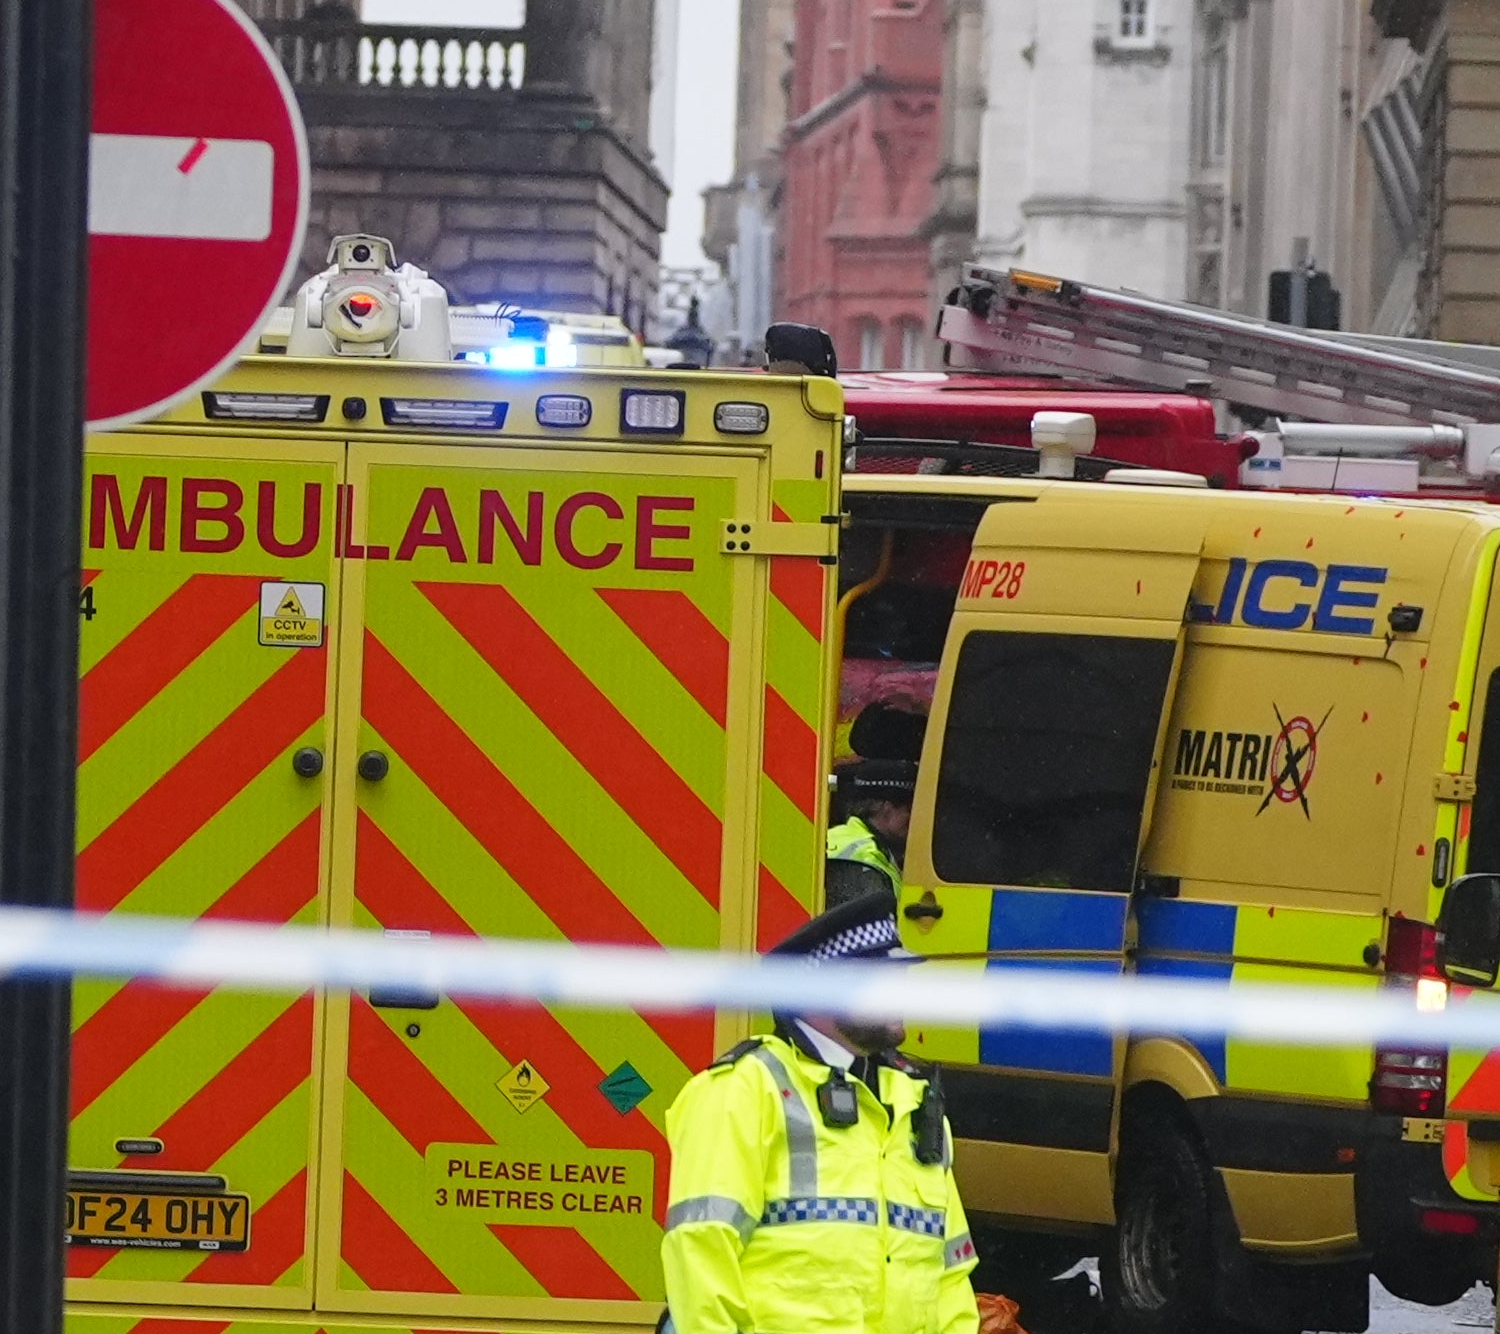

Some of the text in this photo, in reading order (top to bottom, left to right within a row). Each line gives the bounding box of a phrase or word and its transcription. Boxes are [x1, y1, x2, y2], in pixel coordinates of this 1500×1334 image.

[88, 473, 695, 572] MBULANCE
[959, 560, 1026, 599] MP28
[274, 619, 306, 630] CCTV
[276, 633, 317, 642] operation
[448, 1159, 627, 1185] PLEASE LEAVE
[435, 1188, 642, 1215] 3 METRES CLEAR
[165, 1199, 240, 1236] OHY
